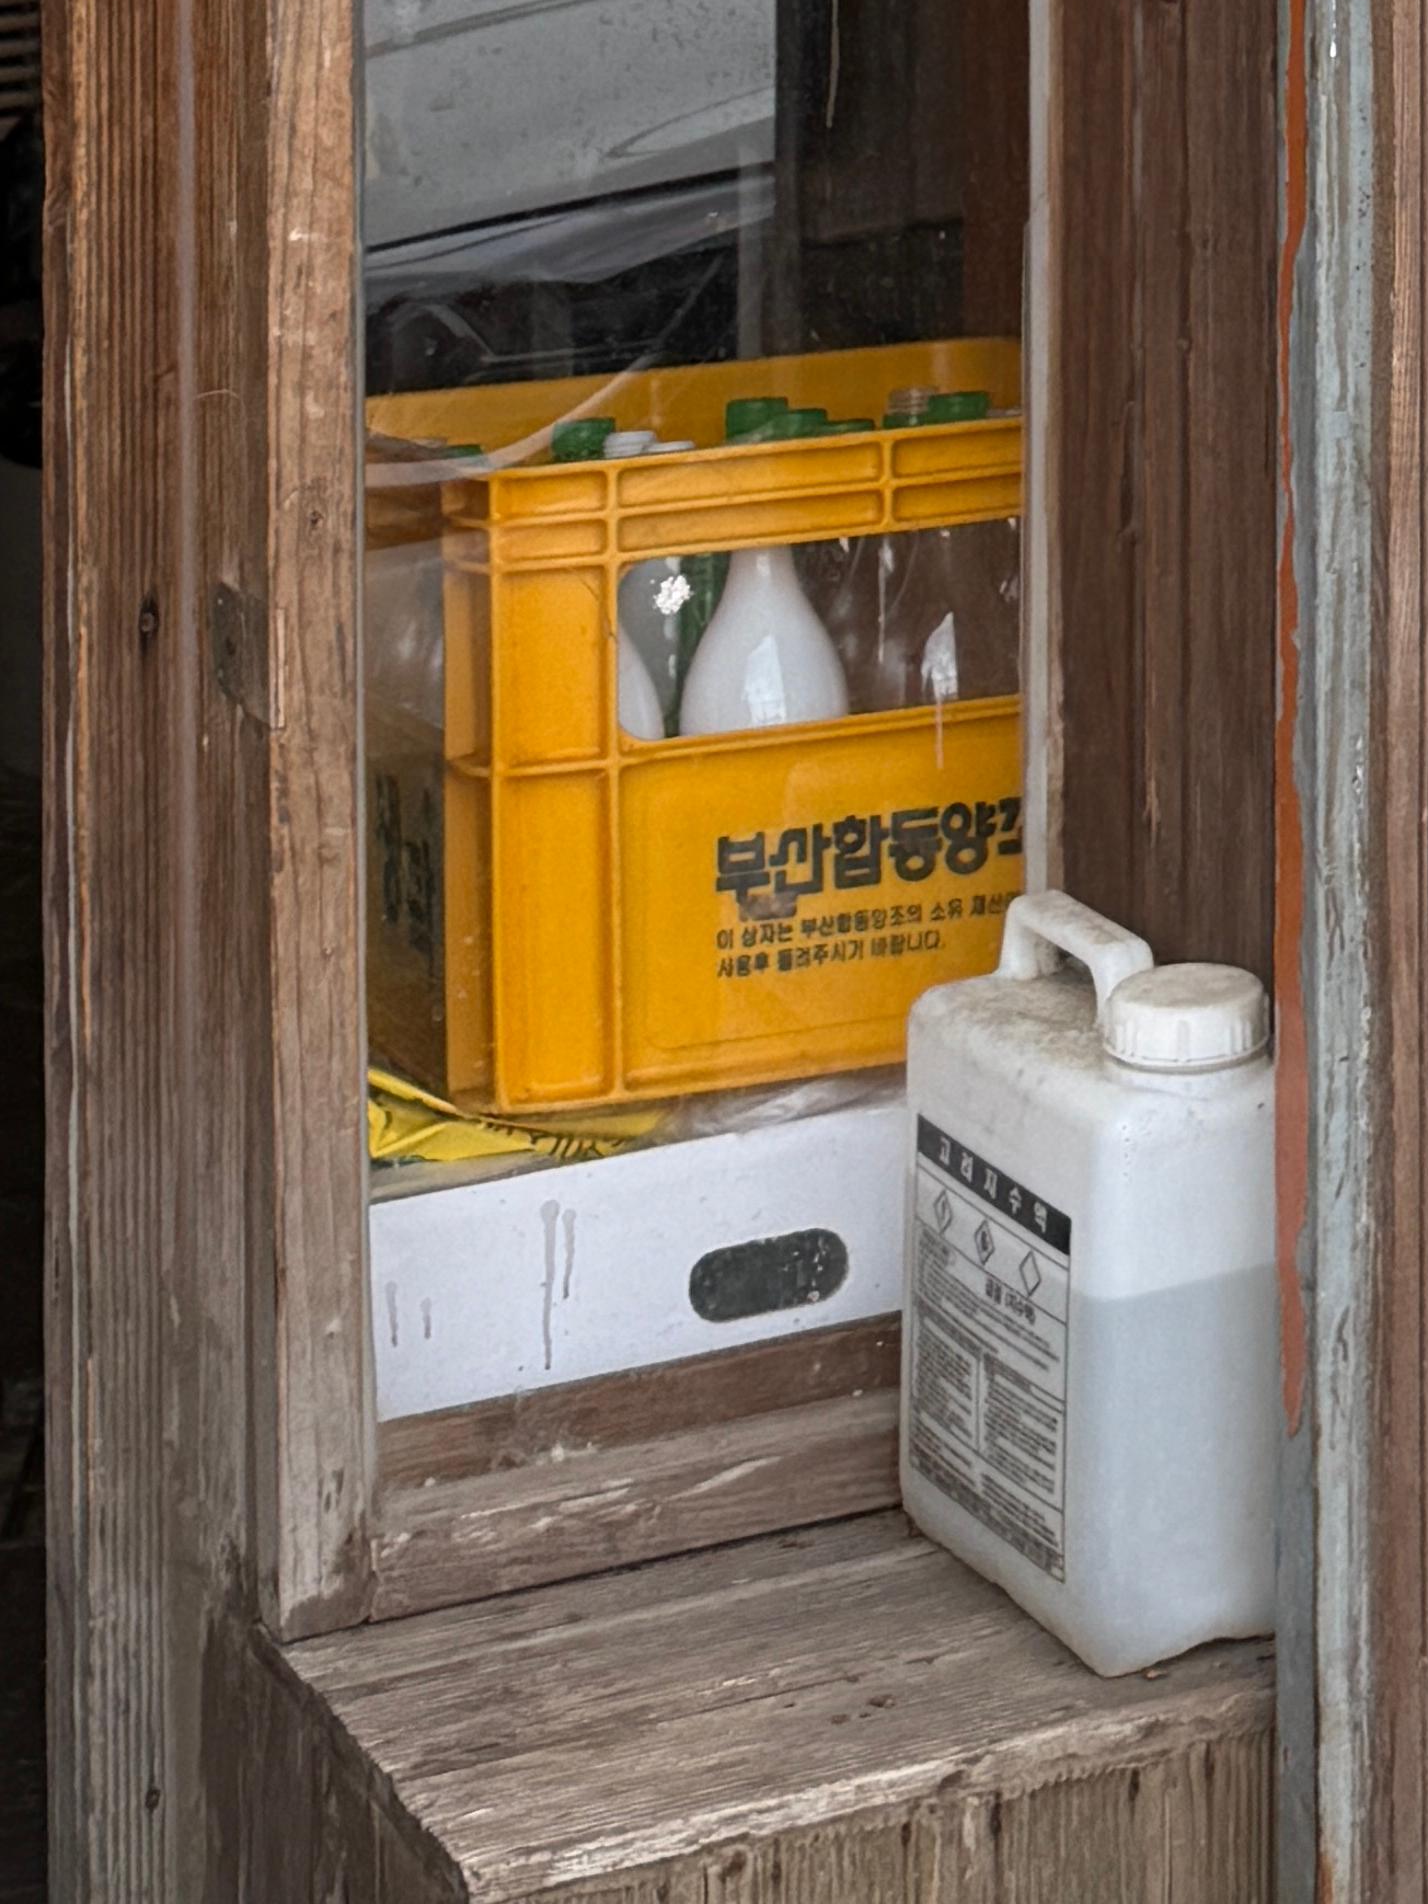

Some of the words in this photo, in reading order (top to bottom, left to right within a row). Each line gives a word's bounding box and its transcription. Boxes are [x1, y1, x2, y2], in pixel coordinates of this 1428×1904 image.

[716, 928, 734, 951] 이
[741, 922, 794, 949] 상자는
[930, 897, 963, 922] 소유
